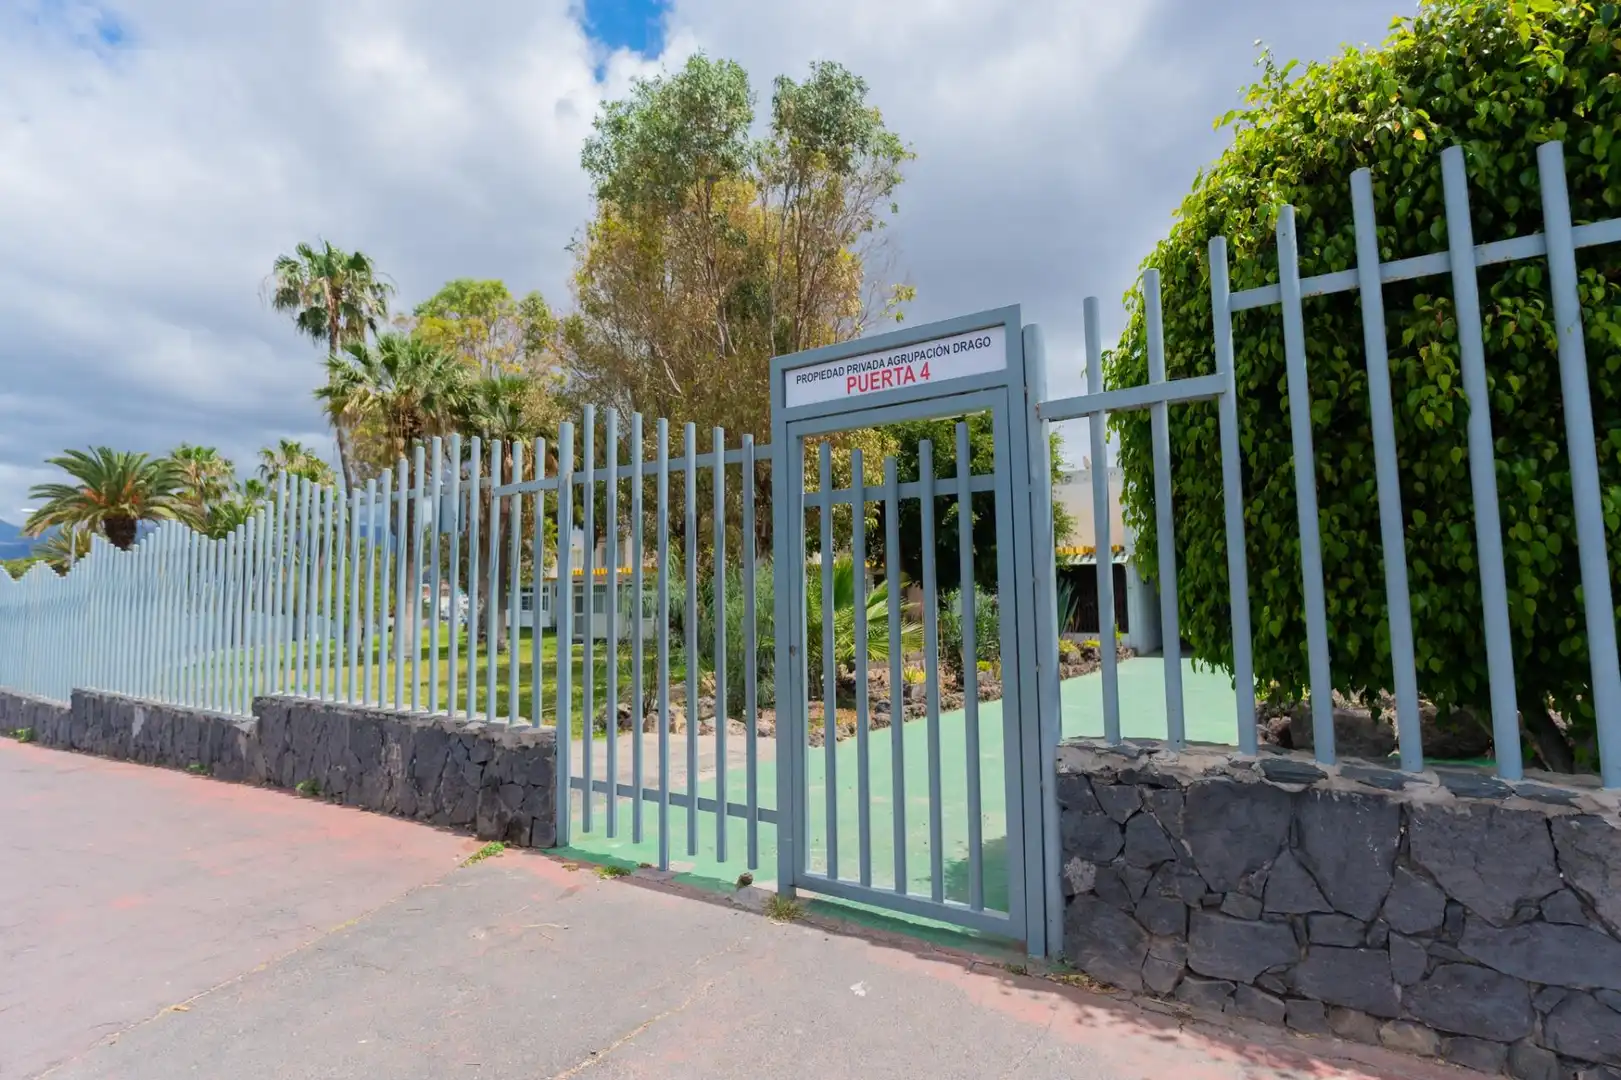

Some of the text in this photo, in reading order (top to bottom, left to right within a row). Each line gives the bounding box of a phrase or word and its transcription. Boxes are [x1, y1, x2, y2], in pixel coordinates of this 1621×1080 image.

[796, 336, 991, 384] PROPIEDAD PRIVADA AGRUPACIÓN DRAGO
[846, 362, 931, 394] PUERTA 4
